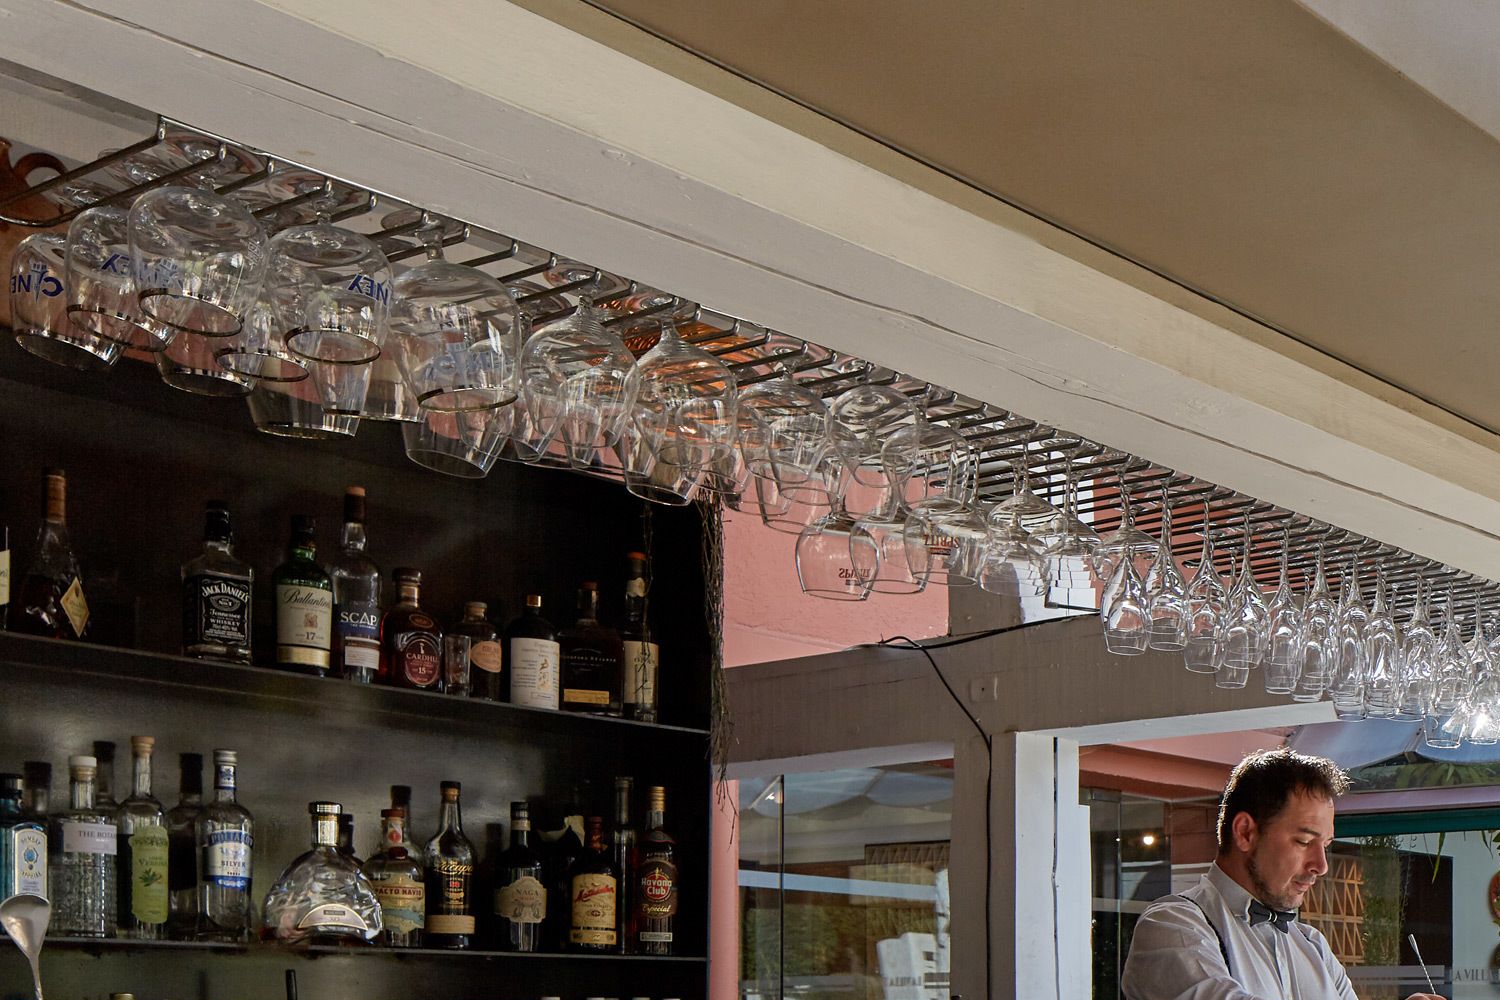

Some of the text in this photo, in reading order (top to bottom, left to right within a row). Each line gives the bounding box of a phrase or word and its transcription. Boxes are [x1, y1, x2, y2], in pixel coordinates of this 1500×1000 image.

[202, 583, 249, 602] JACK DANIEL'S
[210, 618, 240, 627] WHISKEY
[340, 612, 379, 627] SCAP
[305, 631, 316, 640] 17
[78, 830, 116, 839] THE BOTA
[221, 859, 246, 868] SILVER
[641, 879, 672, 888] Havana
[516, 888, 539, 897] NAGA
[647, 887, 666, 895] Club
